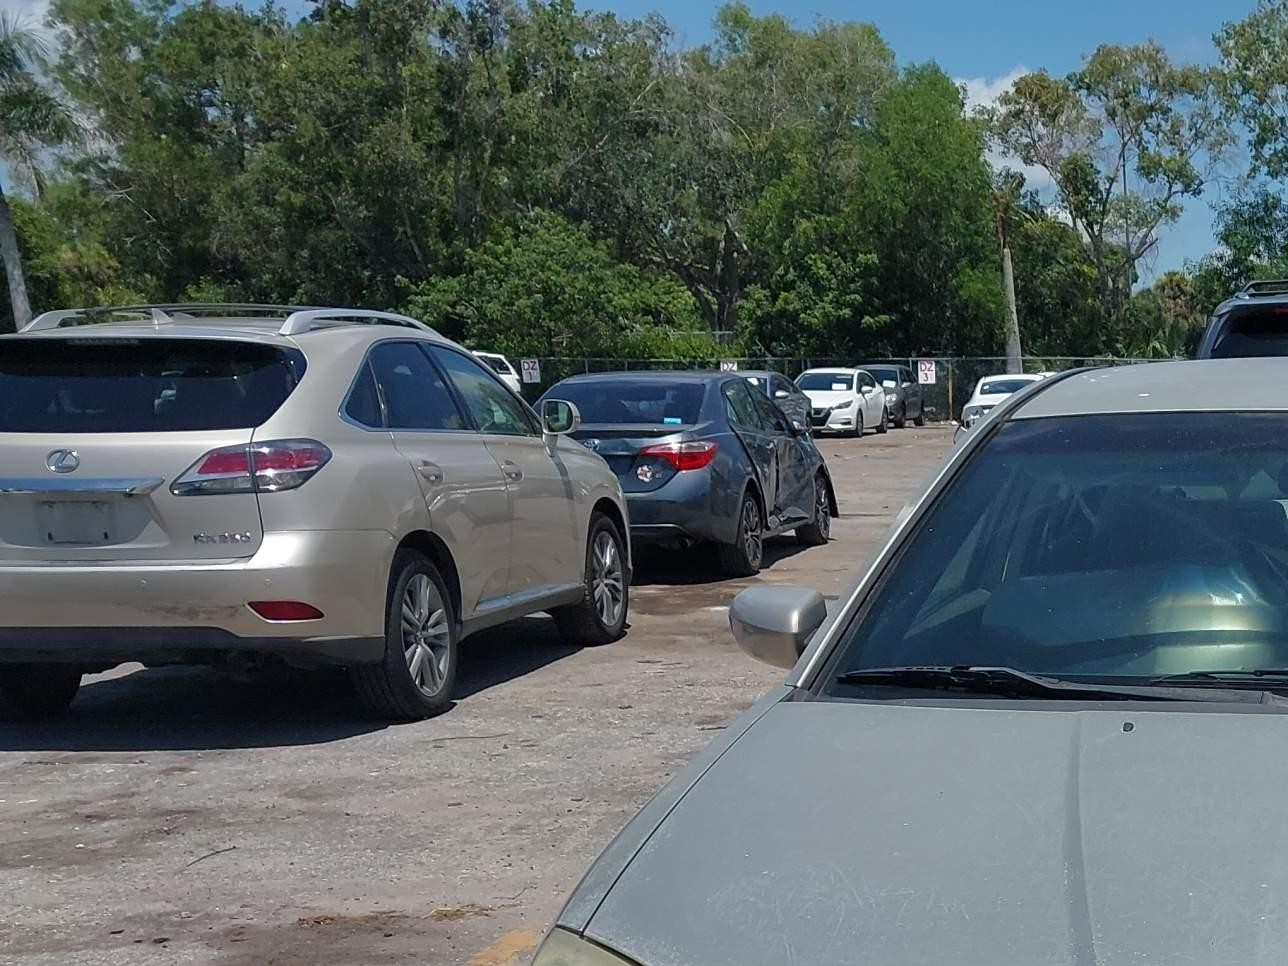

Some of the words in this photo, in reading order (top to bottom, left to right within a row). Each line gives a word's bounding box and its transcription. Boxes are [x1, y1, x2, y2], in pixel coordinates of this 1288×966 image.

[522, 361, 537, 371] DZ
[920, 361, 934, 372] DZ
[528, 371, 533, 381] 1
[923, 373, 929, 382] 3
